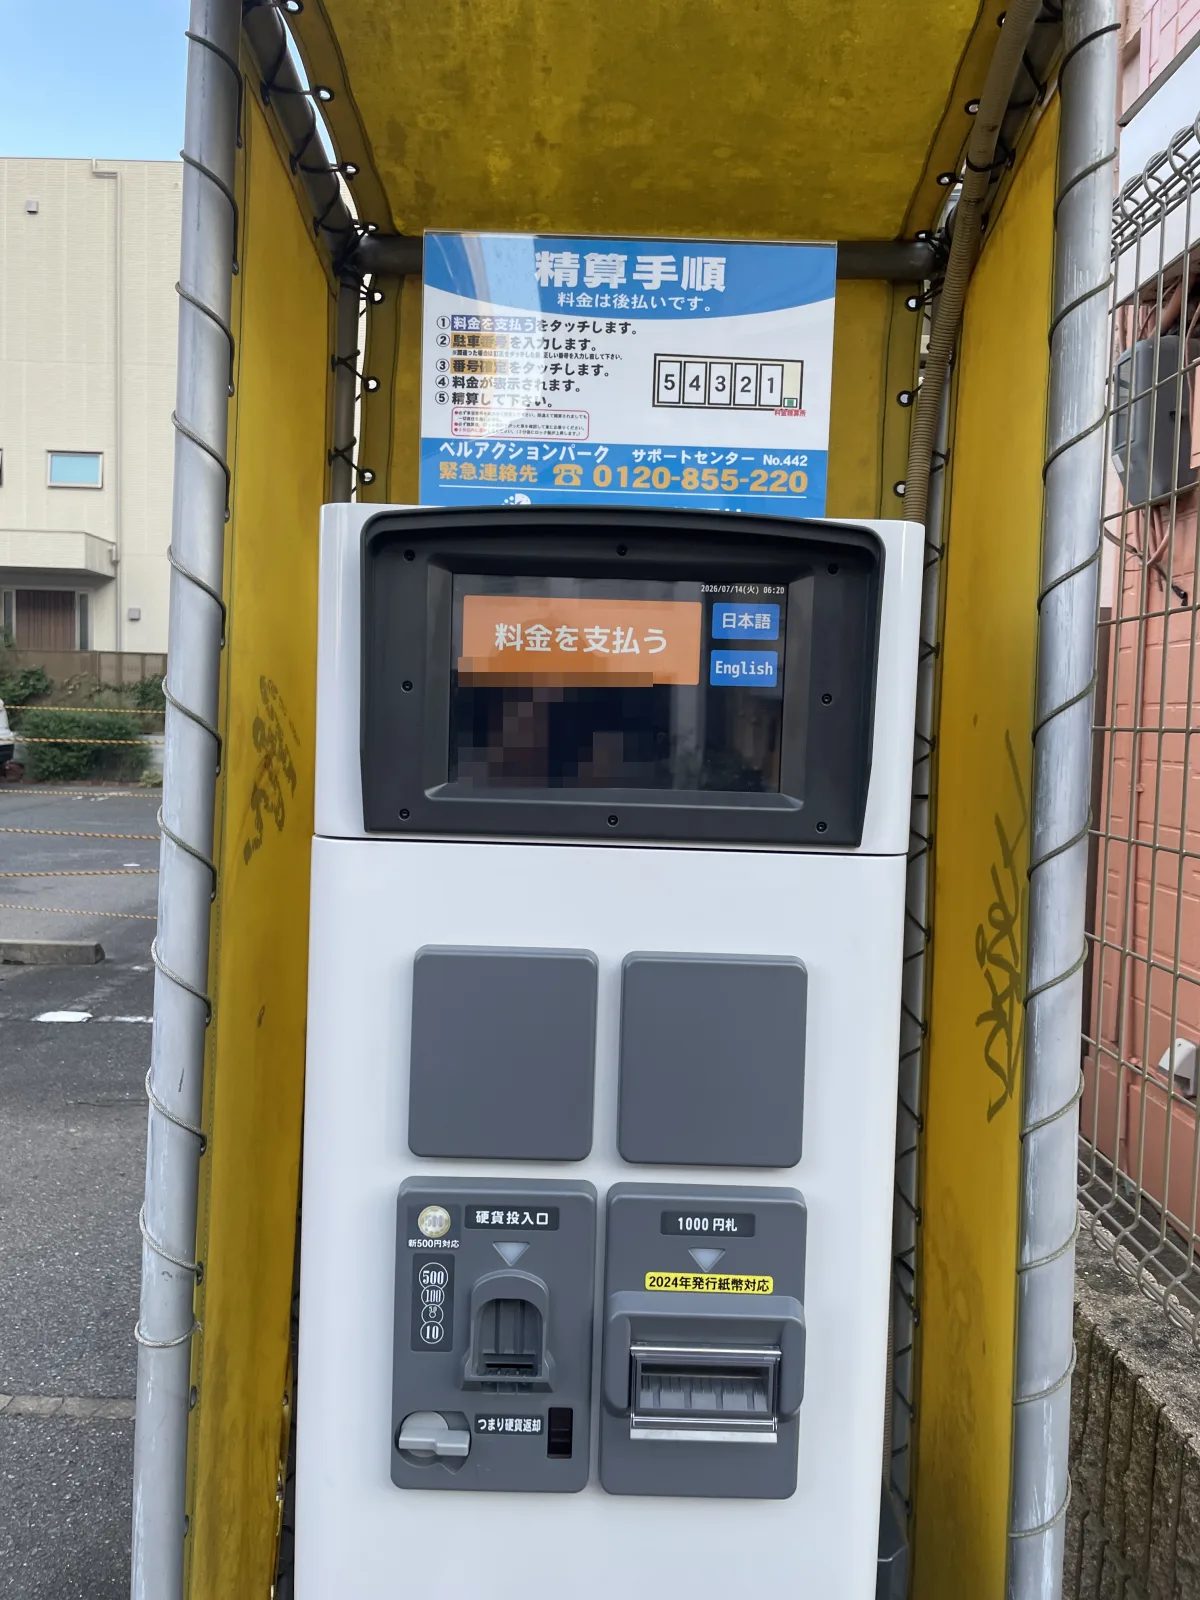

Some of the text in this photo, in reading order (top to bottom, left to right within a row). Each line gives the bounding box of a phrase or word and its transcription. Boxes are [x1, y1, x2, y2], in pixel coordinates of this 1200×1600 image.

[534, 251, 726, 292] 精算手順
[557, 292, 711, 312] 料金は後払いです。
[663, 373, 774, 393] 5 4 3 2 1
[439, 441, 808, 467] ベルアクションパーク サポートセンター No.442
[439, 461, 808, 493] 緊急連絡先 0120-855-220
[701, 583, 785, 596] 2026/07/14(火) 06:20
[721, 612, 771, 631] 日本語
[495, 622, 667, 655] 料金を支払う
[715, 659, 773, 678] English
[475, 1210, 549, 1226] 硬貨投入口
[677, 1217, 737, 1232] 1000 円札
[408, 1239, 460, 1249] 新500円対応
[422, 1270, 444, 1285] 500
[649, 1276, 770, 1292] 2024年発行紙幣対応
[425, 1289, 441, 1303] 100
[426, 1325, 439, 1339] 10
[477, 1418, 541, 1433] つまり硬貨返却
